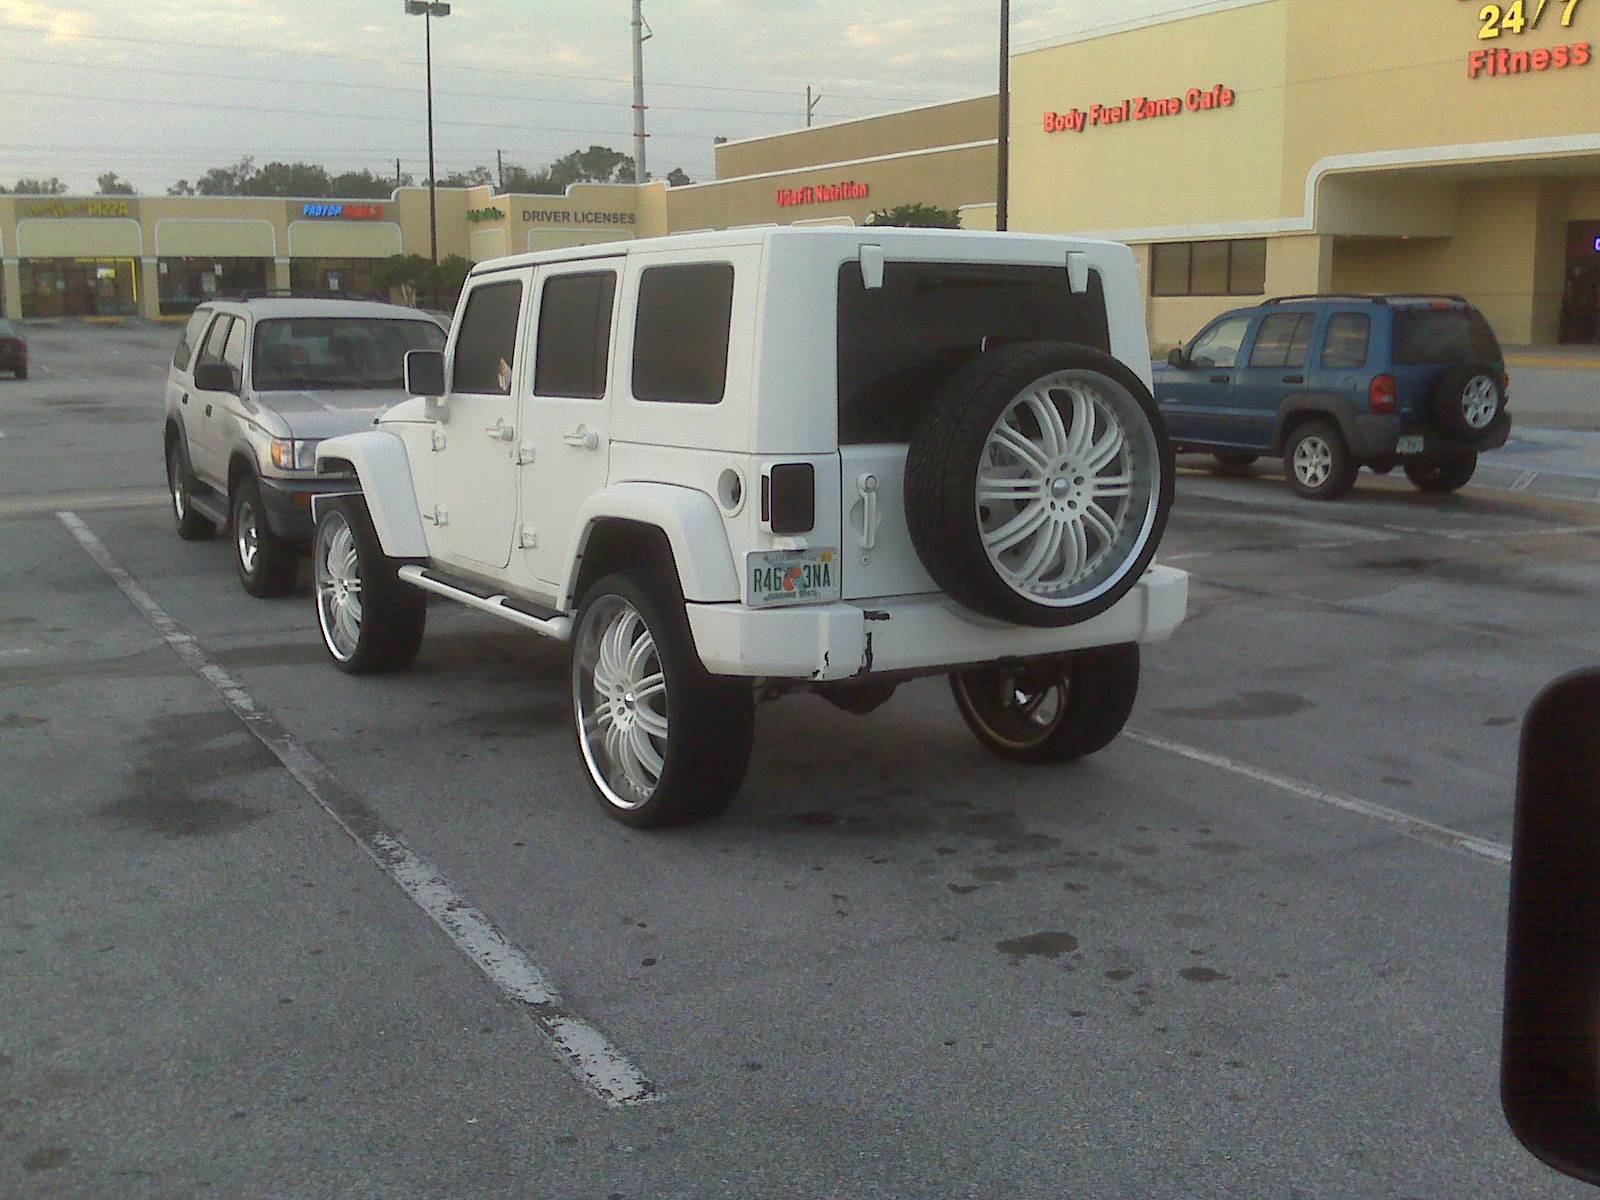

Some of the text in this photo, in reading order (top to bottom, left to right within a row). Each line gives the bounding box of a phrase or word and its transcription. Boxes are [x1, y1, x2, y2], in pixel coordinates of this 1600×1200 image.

[1477, 0, 1580, 40] 24/7
[1468, 42, 1591, 79] Fitness
[1044, 84, 1235, 133] Body Fuel Zone Cafe
[815, 181, 869, 203] Nutrition
[522, 210, 637, 224] DRIVER LICENSES
[803, 563, 831, 588] 3NA
